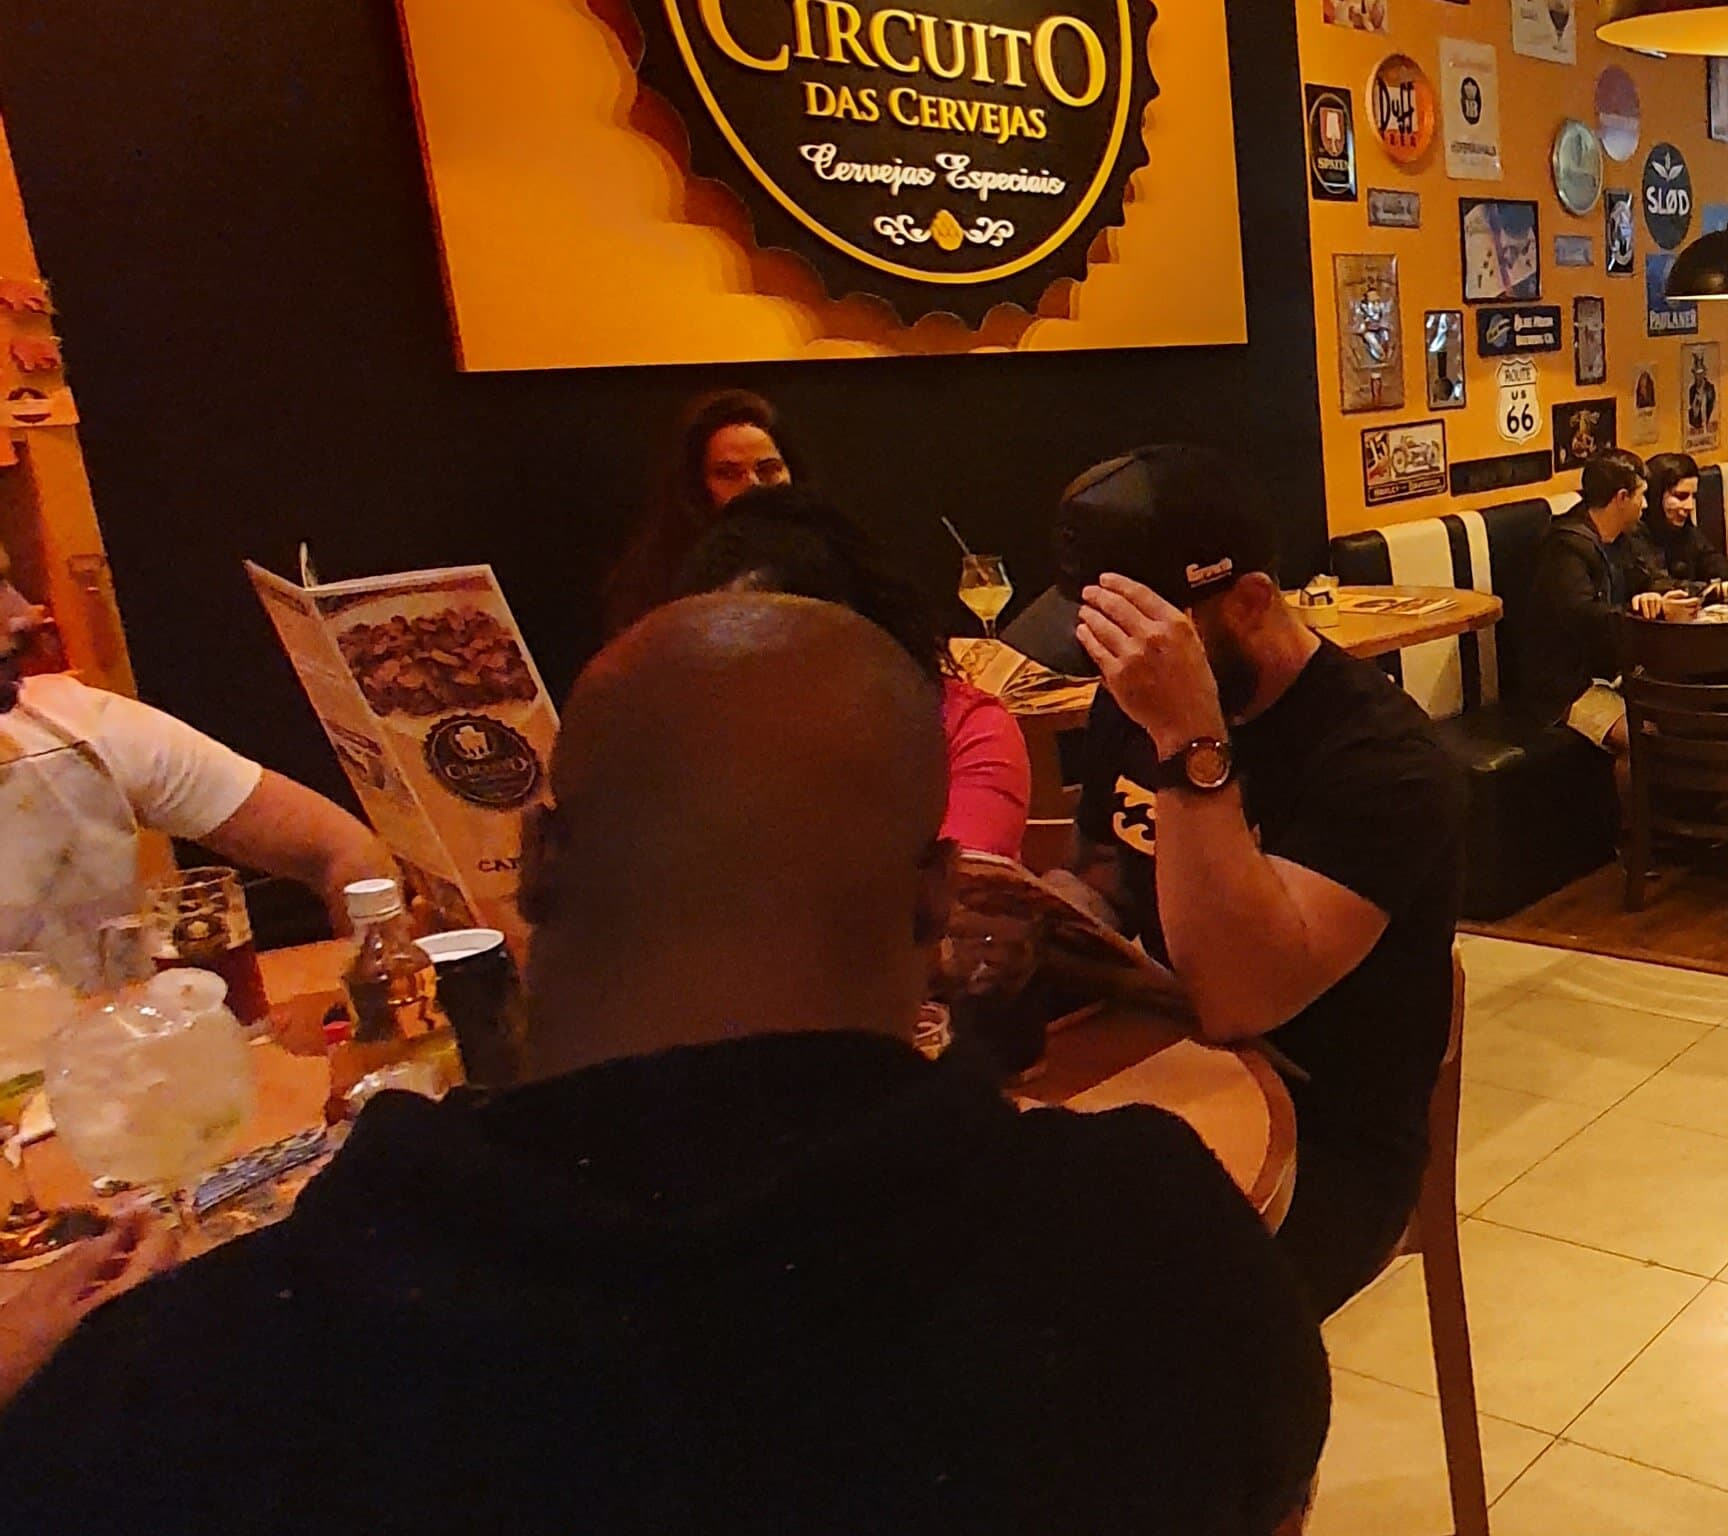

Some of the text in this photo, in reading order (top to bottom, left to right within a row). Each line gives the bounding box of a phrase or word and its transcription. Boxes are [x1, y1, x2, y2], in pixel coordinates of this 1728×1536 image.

[803, 82, 1048, 145] DAS CERVEJAS
[1376, 77, 1415, 136] Duff
[800, 143, 1066, 202] Cervejas Especiais
[1646, 186, 1690, 215] SLØD
[1504, 366, 1532, 383] ROUTE
[1506, 403, 1534, 434] 66
